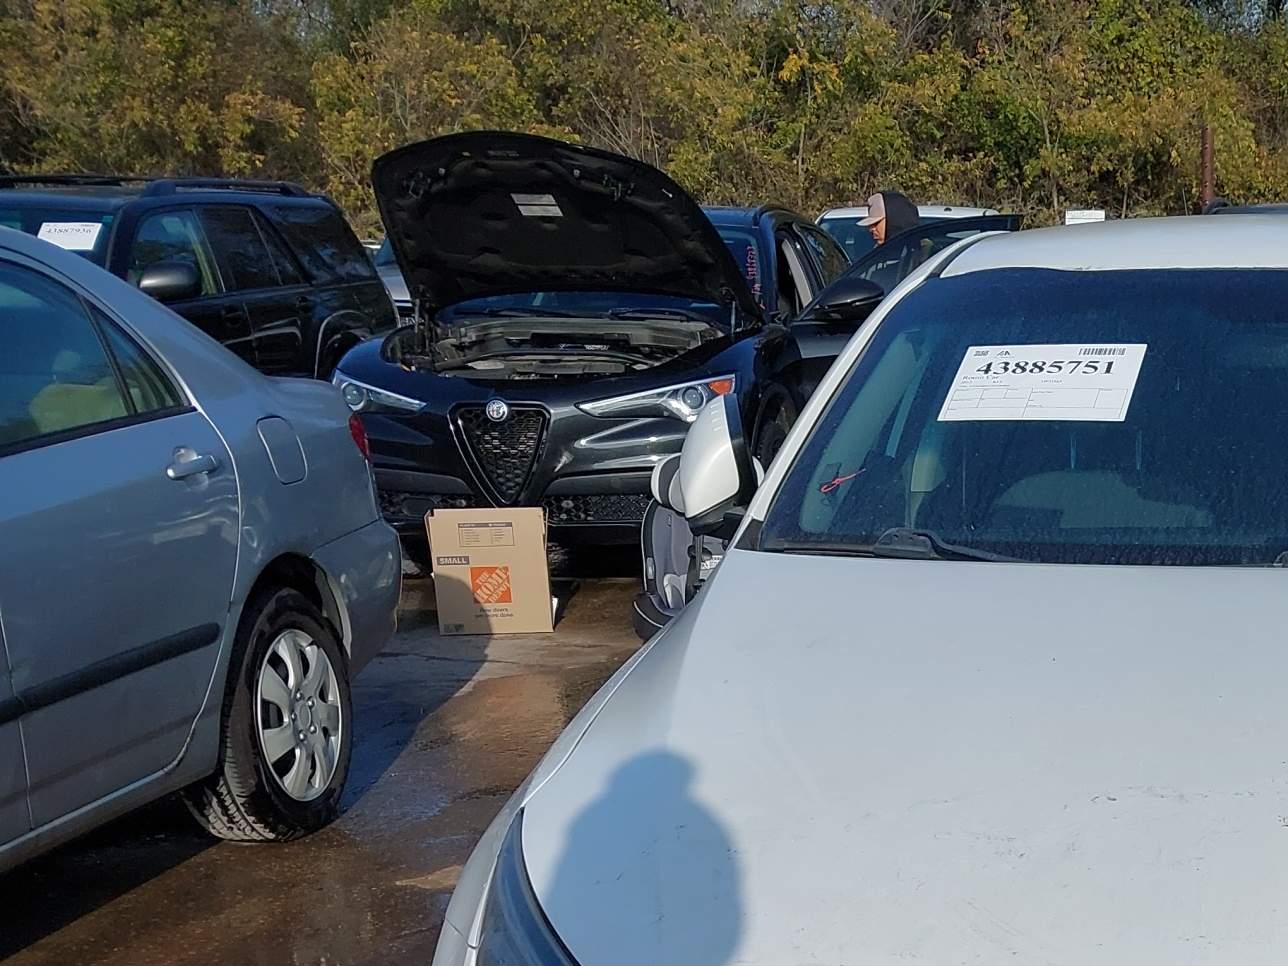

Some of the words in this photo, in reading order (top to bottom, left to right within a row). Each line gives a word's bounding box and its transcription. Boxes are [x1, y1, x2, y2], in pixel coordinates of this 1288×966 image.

[975, 360, 1115, 375] 43885751
[438, 557, 468, 565] SMALL
[474, 566, 509, 604] HOME
